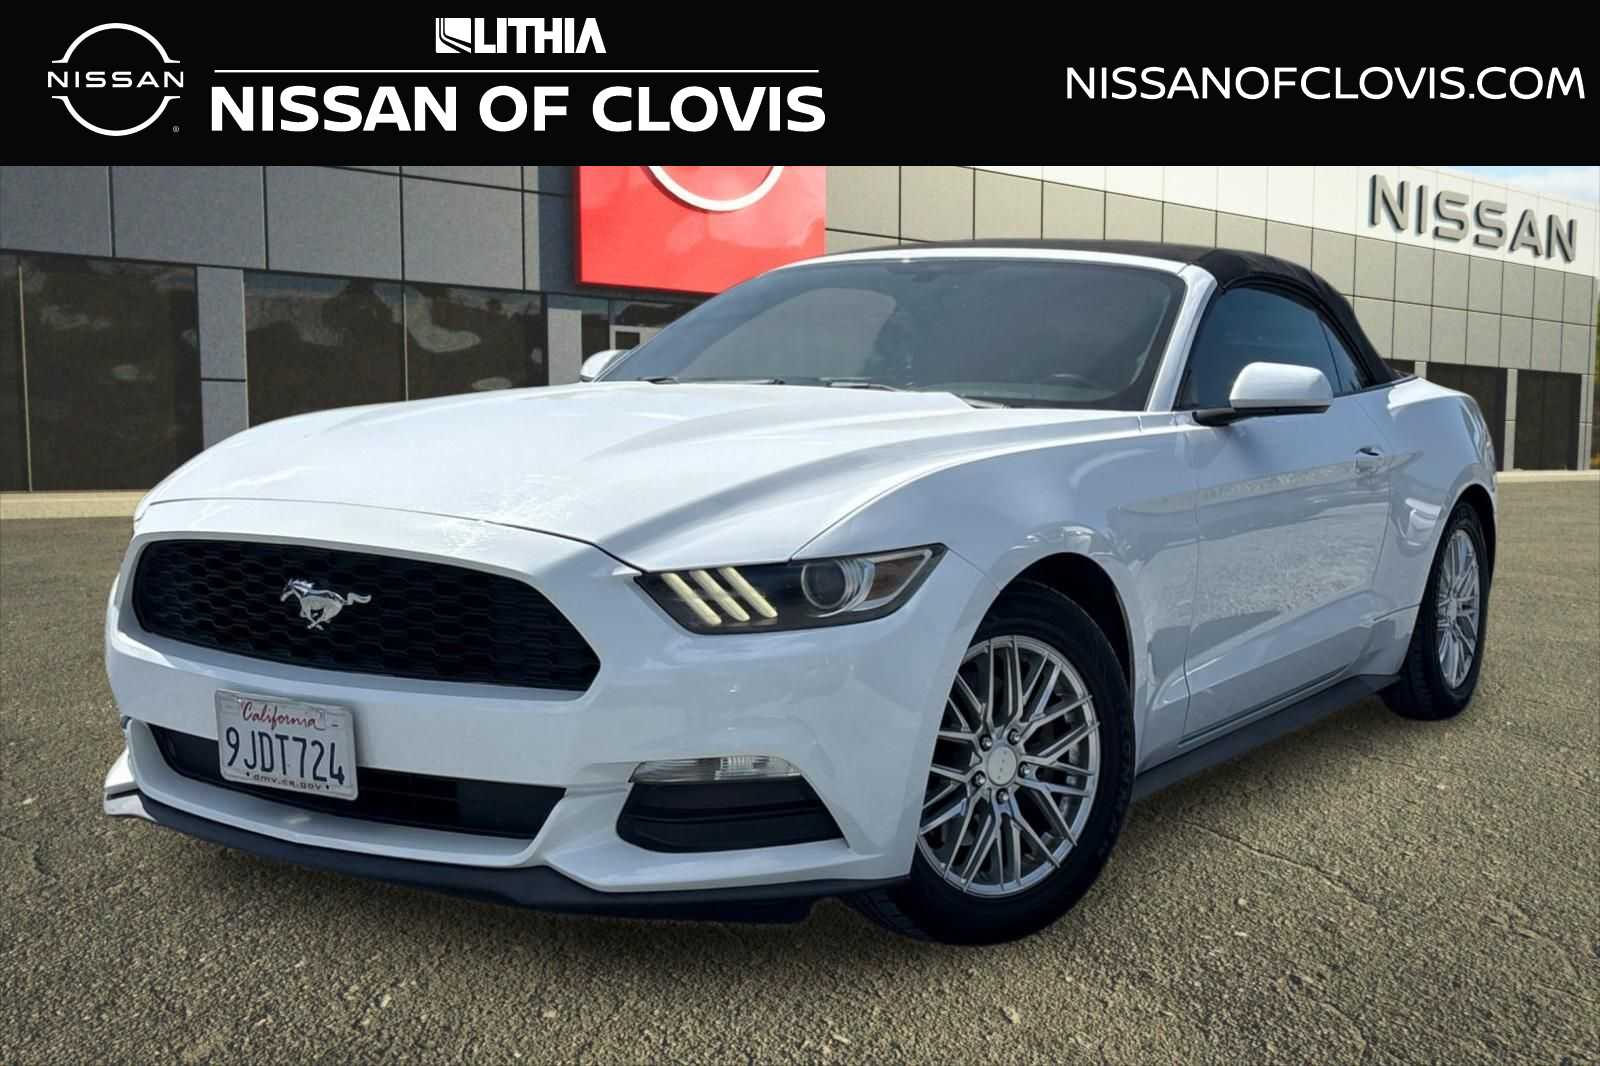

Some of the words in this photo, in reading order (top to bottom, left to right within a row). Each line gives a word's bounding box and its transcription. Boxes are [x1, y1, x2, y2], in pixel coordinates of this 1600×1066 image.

[1369, 174, 1577, 263] NISSAN
[241, 700, 325, 731] California
[226, 726, 345, 785] 9JDT724
